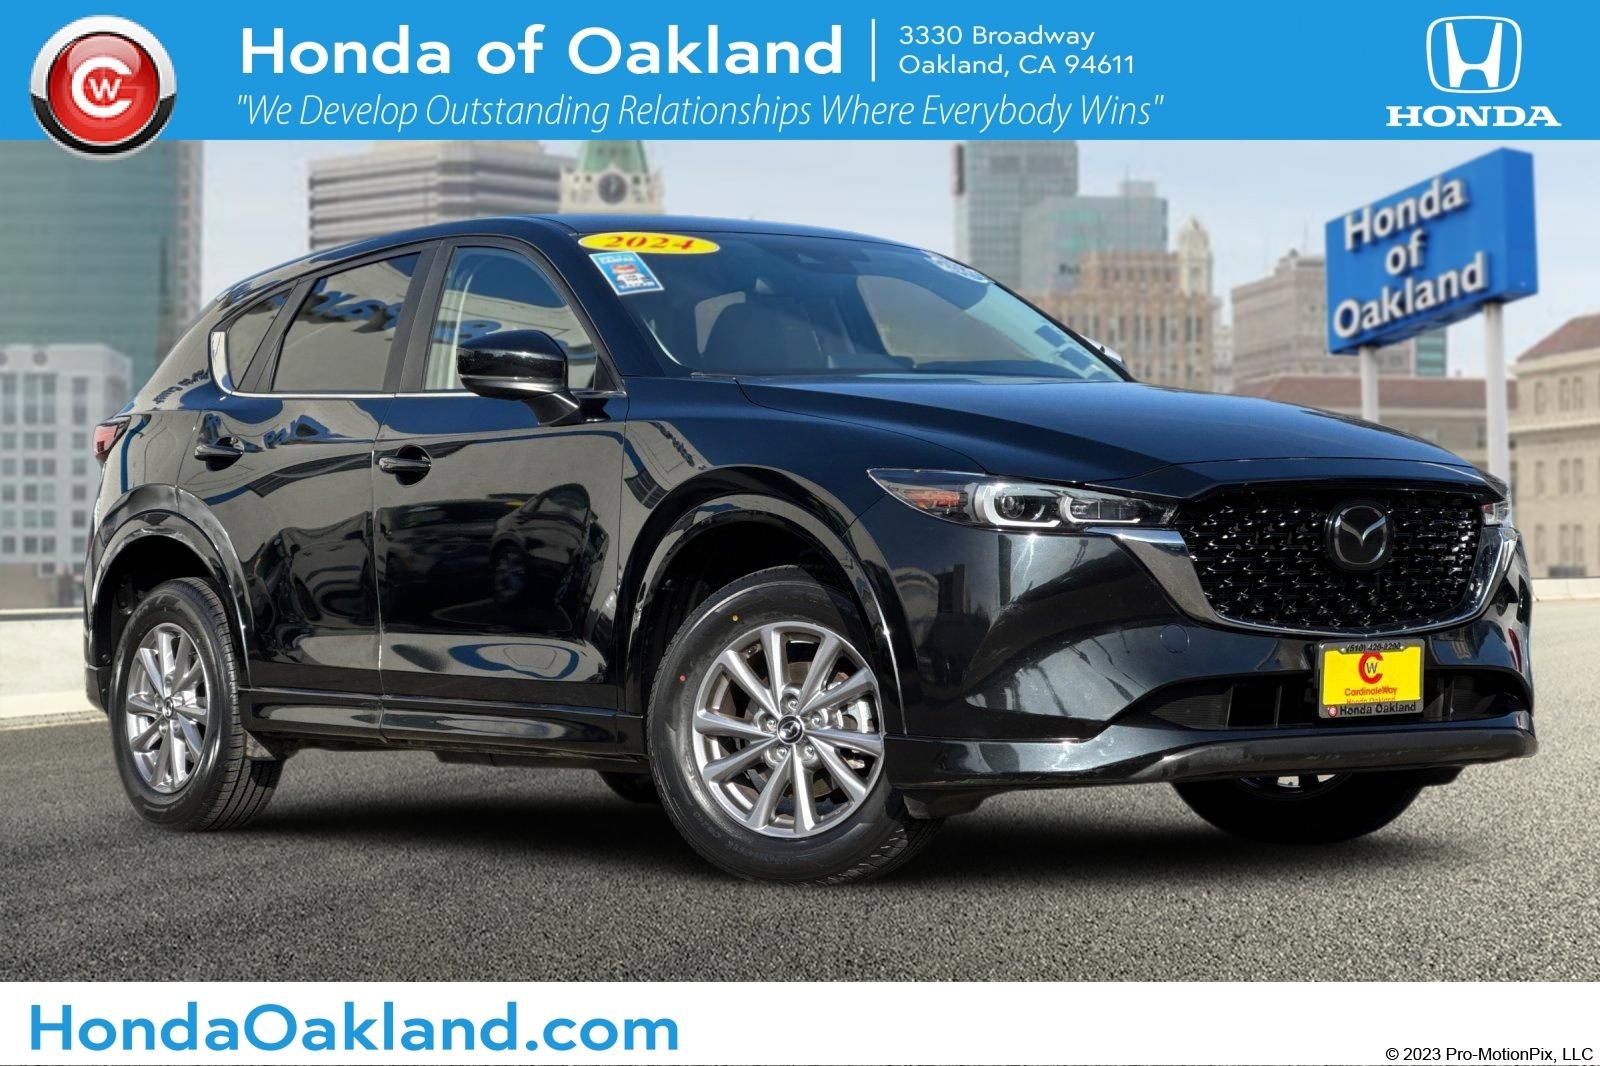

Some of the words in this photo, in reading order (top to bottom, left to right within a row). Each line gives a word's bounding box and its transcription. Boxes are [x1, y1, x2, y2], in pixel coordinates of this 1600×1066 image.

[1344, 176, 1467, 252] Honda
[601, 235, 696, 250] 2024
[1385, 229, 1425, 276] of
[1333, 250, 1489, 339] Oakland
[1340, 704, 1372, 715] Honda
[1375, 701, 1416, 713] Oakland
